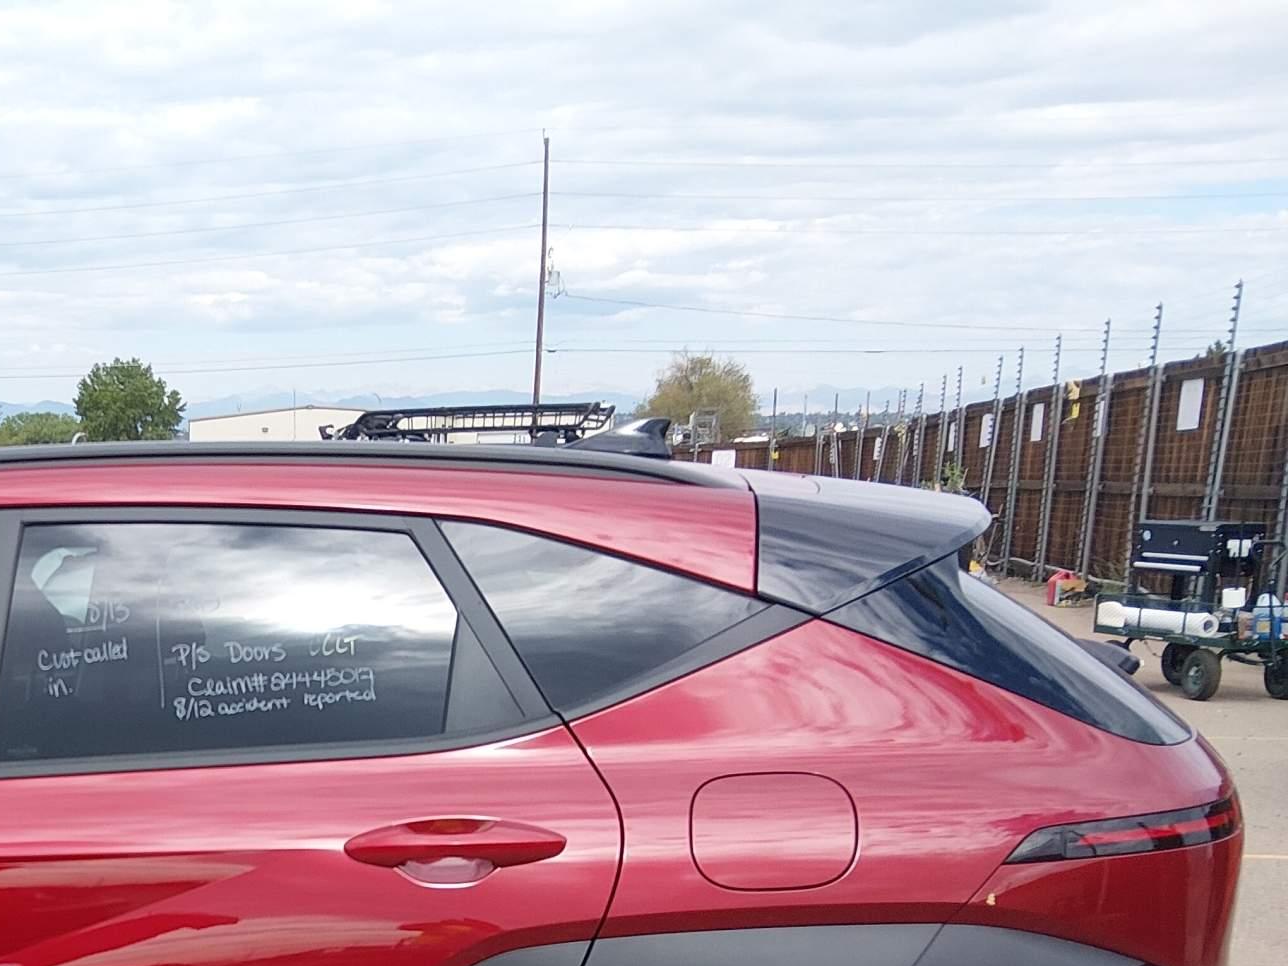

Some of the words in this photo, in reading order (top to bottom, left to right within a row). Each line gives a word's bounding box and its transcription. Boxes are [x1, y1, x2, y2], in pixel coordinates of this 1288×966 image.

[83, 637, 128, 664] called
[223, 641, 288, 664] Doors
[173, 696, 215, 721] 8/12
[217, 696, 292, 715] accident
[303, 689, 377, 711] reported
